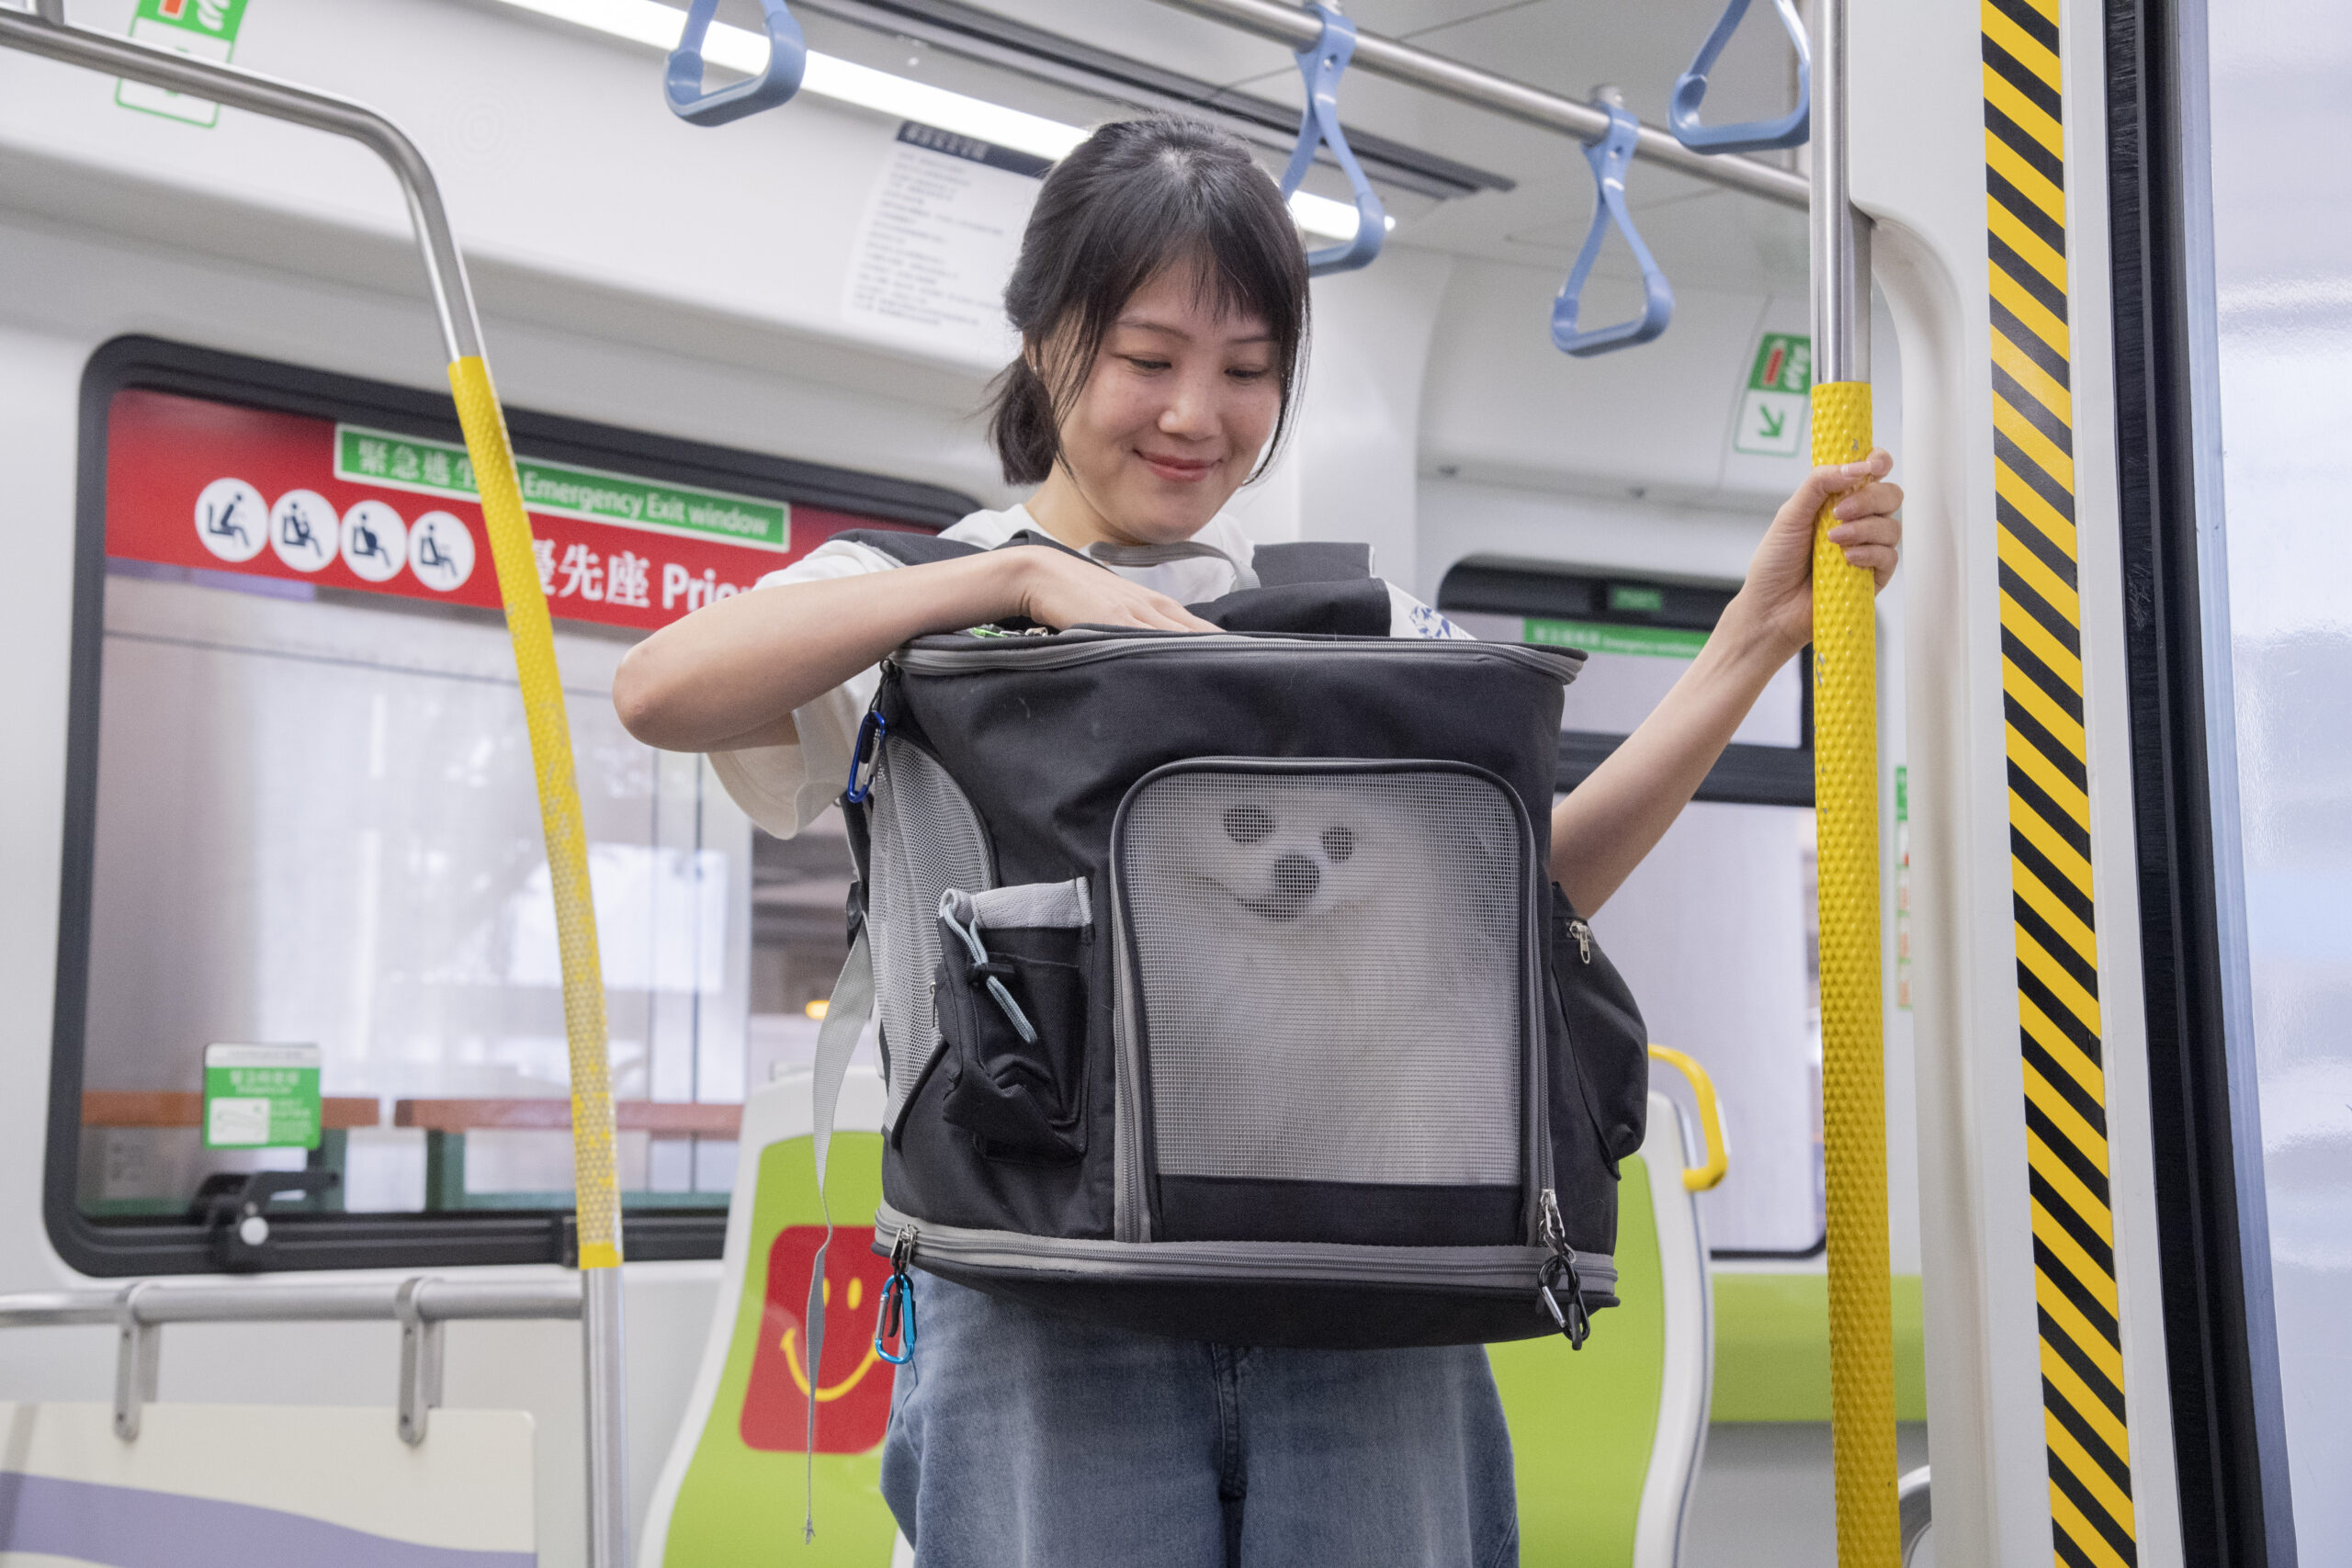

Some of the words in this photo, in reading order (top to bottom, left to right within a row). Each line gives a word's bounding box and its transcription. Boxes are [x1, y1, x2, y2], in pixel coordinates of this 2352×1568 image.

[523, 470, 643, 520] Emergency
[646, 492, 684, 523] Exit
[688, 502, 770, 536] window
